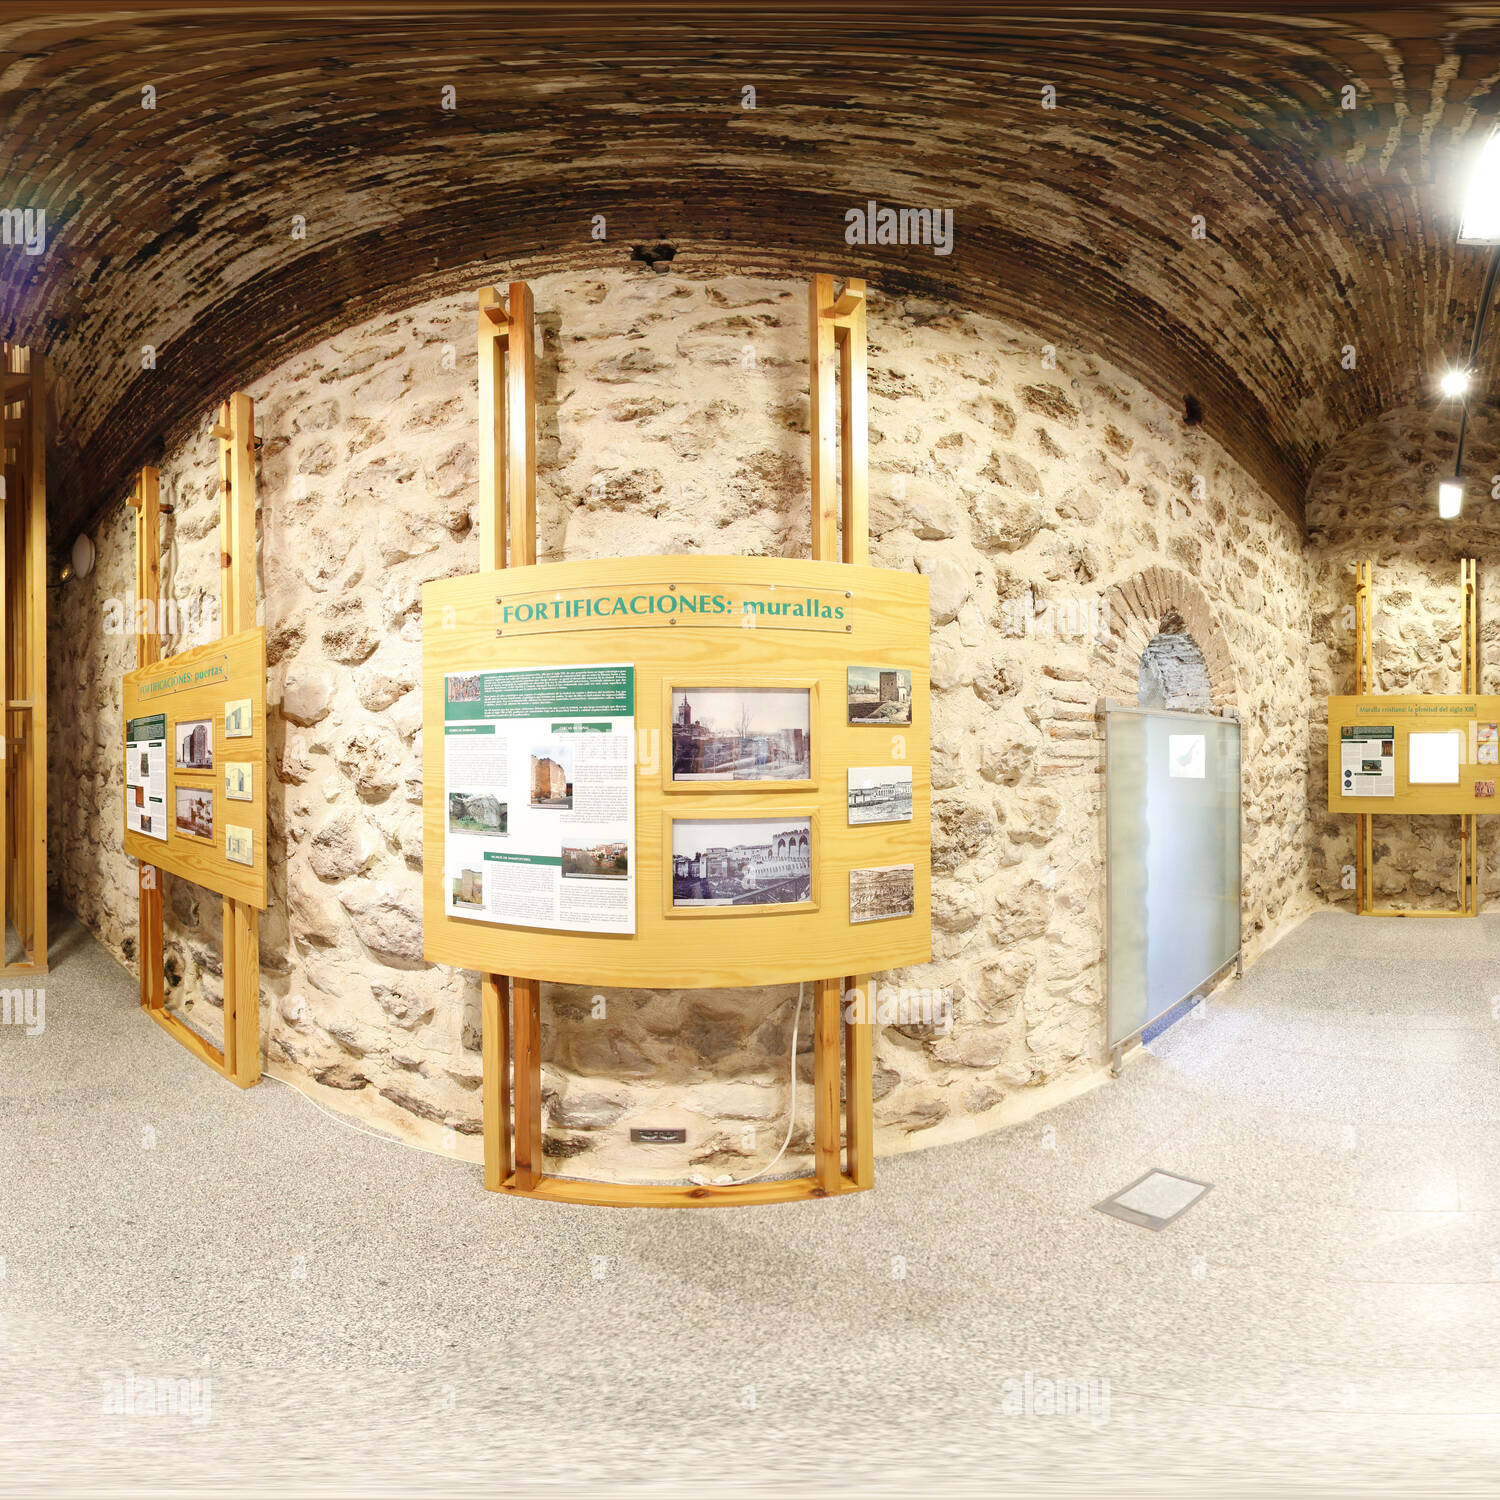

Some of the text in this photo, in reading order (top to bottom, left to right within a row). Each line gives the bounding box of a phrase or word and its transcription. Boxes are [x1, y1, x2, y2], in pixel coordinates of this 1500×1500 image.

[503, 594, 844, 624] FORTIFICACIONES: murallas
[139, 665, 223, 696] FORTIFICACIONES: puertas
